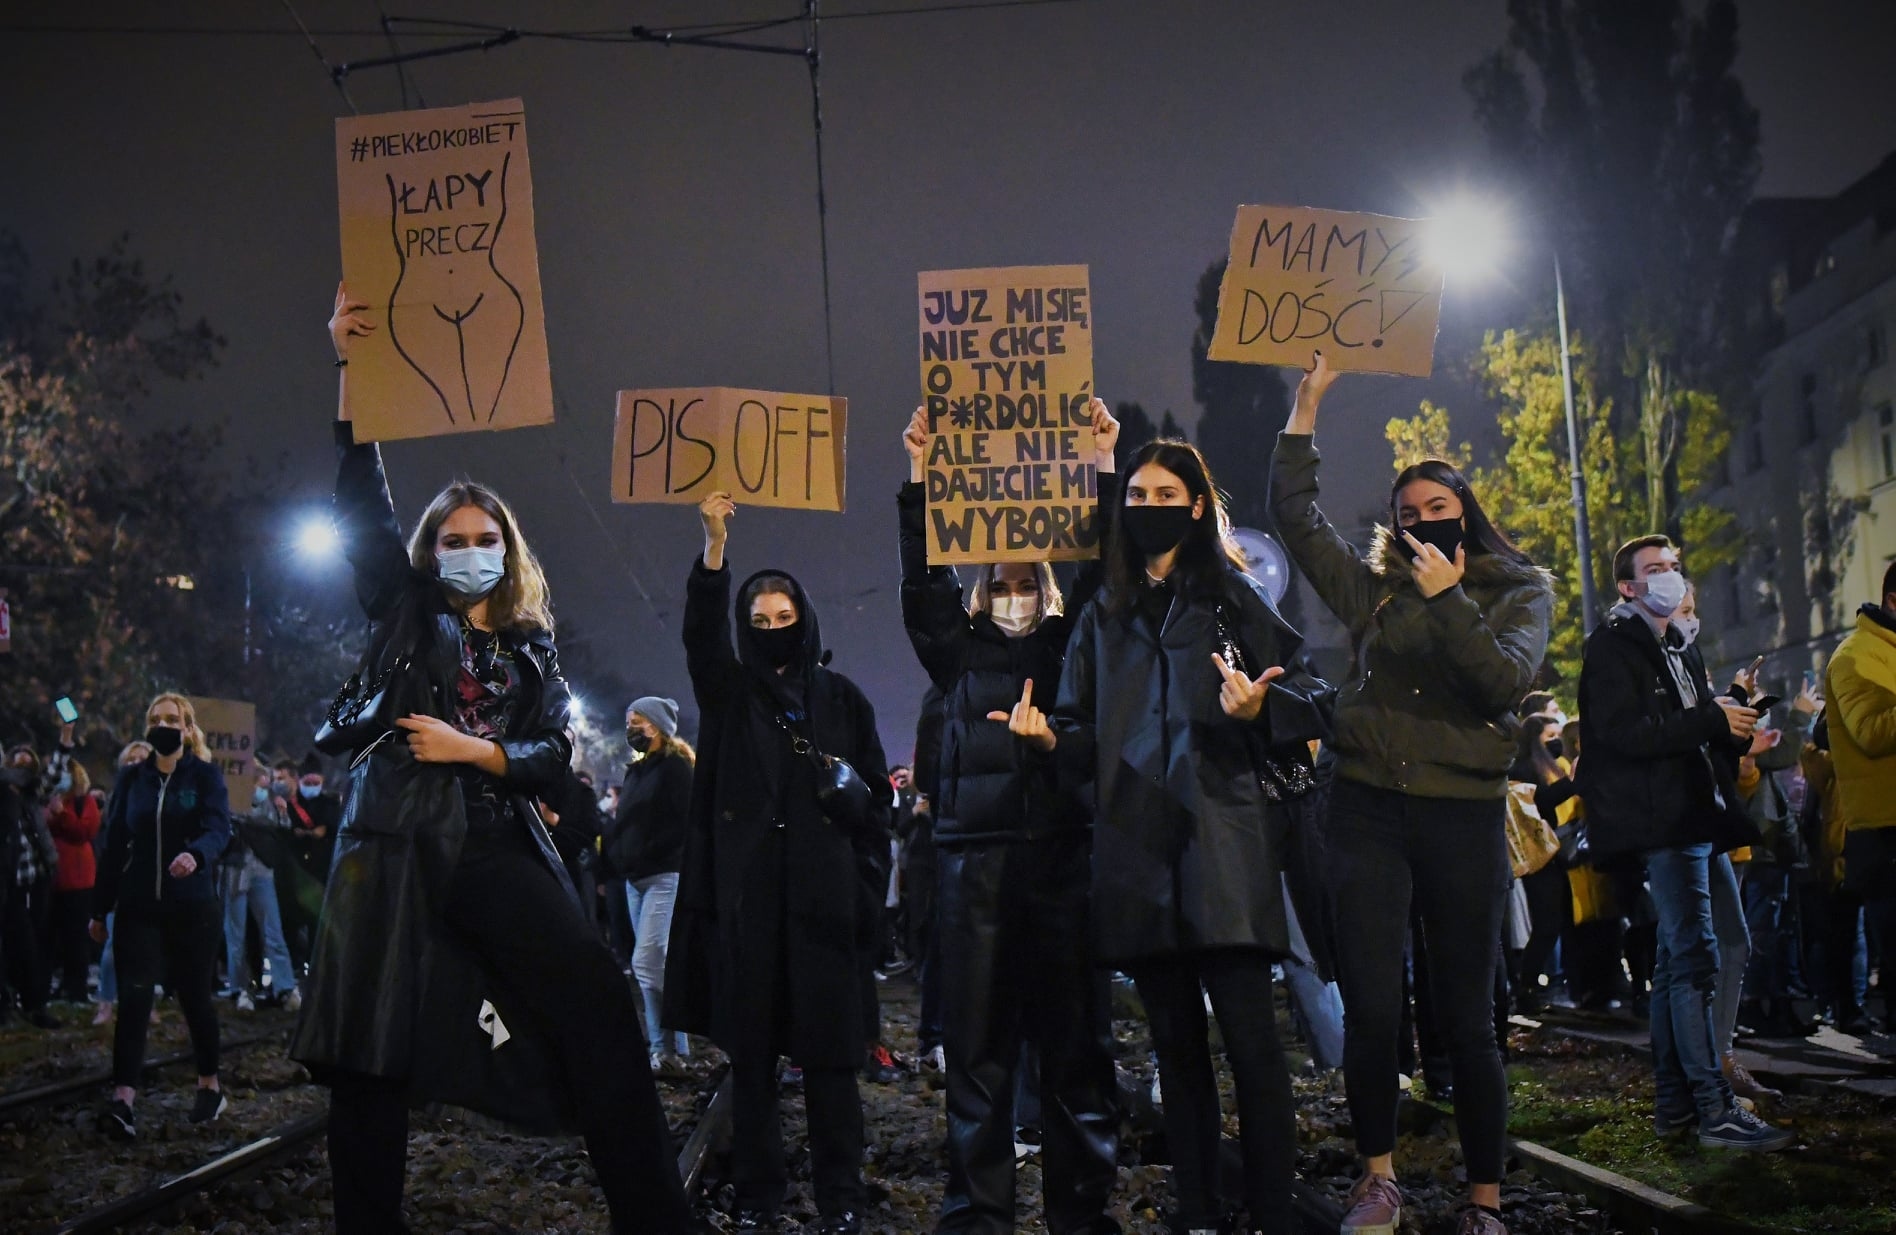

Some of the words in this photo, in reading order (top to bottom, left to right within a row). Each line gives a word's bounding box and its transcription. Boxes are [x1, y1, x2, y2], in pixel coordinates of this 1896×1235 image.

[351, 122, 520, 162] #PIEKŁOKOBIET
[398, 169, 493, 214] ŁAPY
[406, 223, 490, 258] PRECZ
[1250, 218, 1414, 277] MAMY
[924, 289, 993, 325] JUZ
[923, 329, 979, 361] NIE
[989, 325, 1066, 358] CHCE
[927, 364, 952, 394] O
[971, 360, 1046, 391] TYM
[628, 398, 716, 497] PIS
[733, 400, 829, 500] OFF
[928, 433, 991, 466] ALE
[1015, 430, 1079, 462] NIE
[928, 464, 1053, 502] DAJECIE
[1060, 463, 1098, 498] MI
[931, 505, 1100, 552] WYBORU
